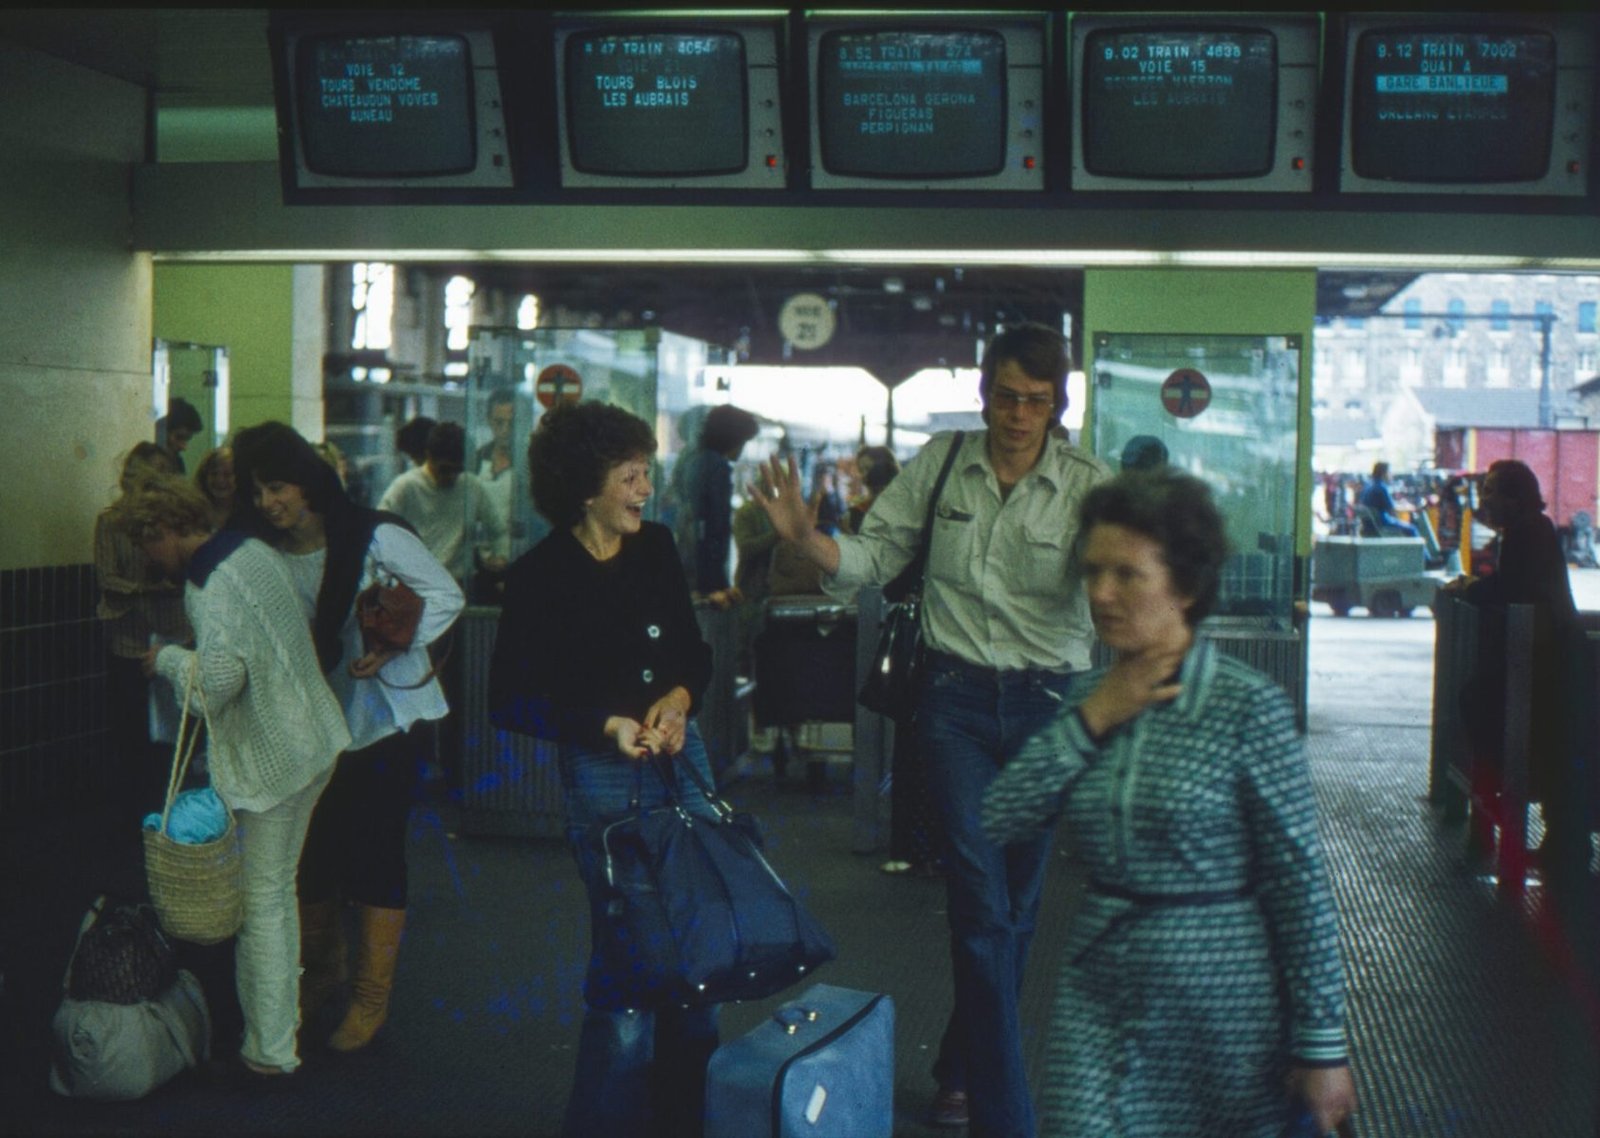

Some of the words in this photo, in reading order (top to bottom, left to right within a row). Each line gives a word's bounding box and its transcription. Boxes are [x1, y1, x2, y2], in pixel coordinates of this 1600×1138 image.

[623, 42, 662, 54] TRAIN
[880, 46, 922, 59] TRAIN
[1147, 45, 1189, 58] TRAIN
[1422, 43, 1464, 57] TRAIN
[1139, 60, 1172, 73] VOIE
[1191, 60, 1206, 73] 15
[1421, 60, 1453, 73] QUAI
[1463, 60, 1472, 73] A
[321, 79, 355, 92] TOURS
[368, 78, 421, 91] VENDOME
[596, 76, 634, 89] TOURS
[656, 76, 697, 89] BLOIS
[1386, 76, 1420, 89] GARE
[1429, 76, 1497, 90] BANLIEUE
[603, 93, 626, 106] LES
[634, 92, 689, 106] AUBRAIS
[844, 93, 916, 106] BARCELONA
[924, 92, 976, 106] GERONA
[868, 108, 934, 120] FIGUERAS
[860, 122, 934, 134] PERPIGNAN
